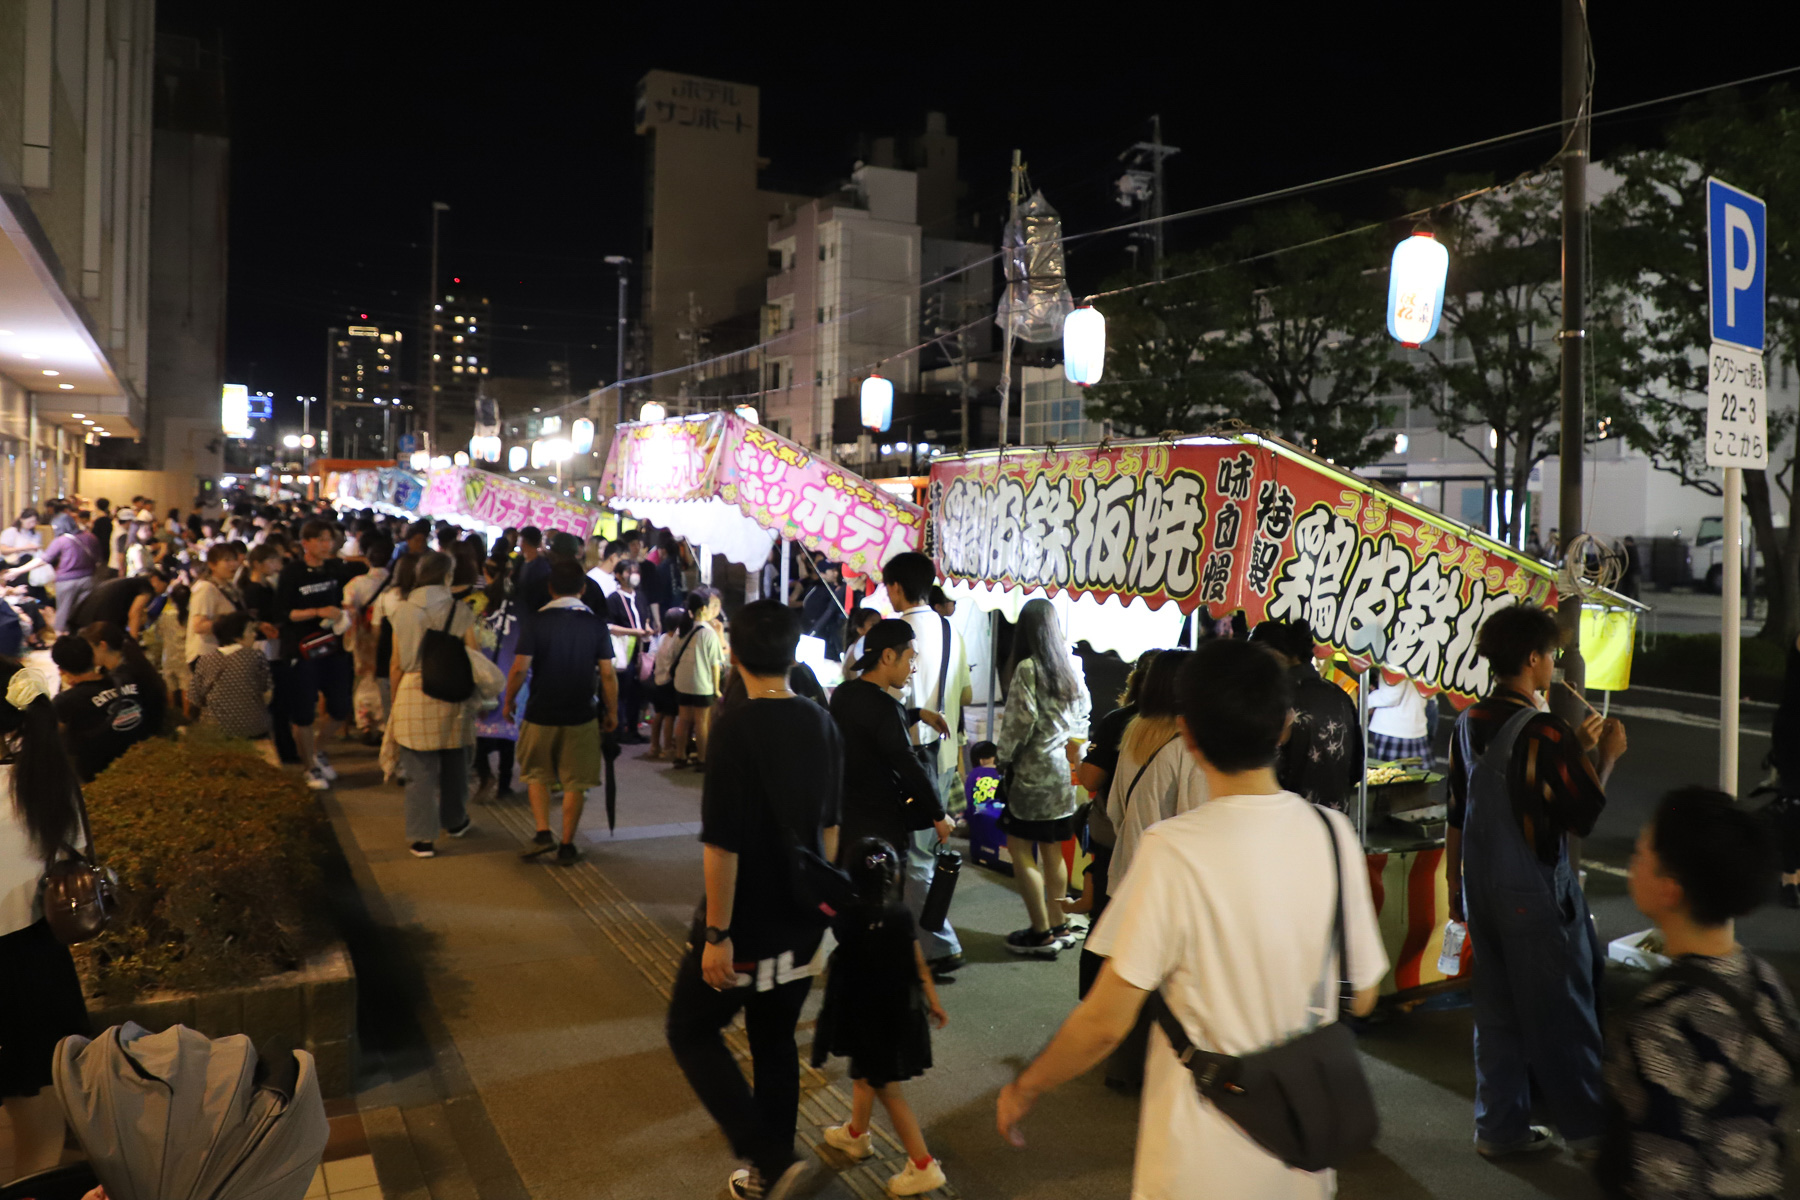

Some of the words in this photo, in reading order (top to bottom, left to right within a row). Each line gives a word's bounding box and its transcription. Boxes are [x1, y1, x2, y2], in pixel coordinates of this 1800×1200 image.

[1724, 202, 1757, 328] P
[1713, 430, 1763, 459] ここから
[1721, 392, 1756, 425] 22-3
[1202, 451, 1254, 604] 味自慢
[1251, 479, 1295, 598] 特製
[1268, 503, 1518, 697] 鶏皮鉄板
